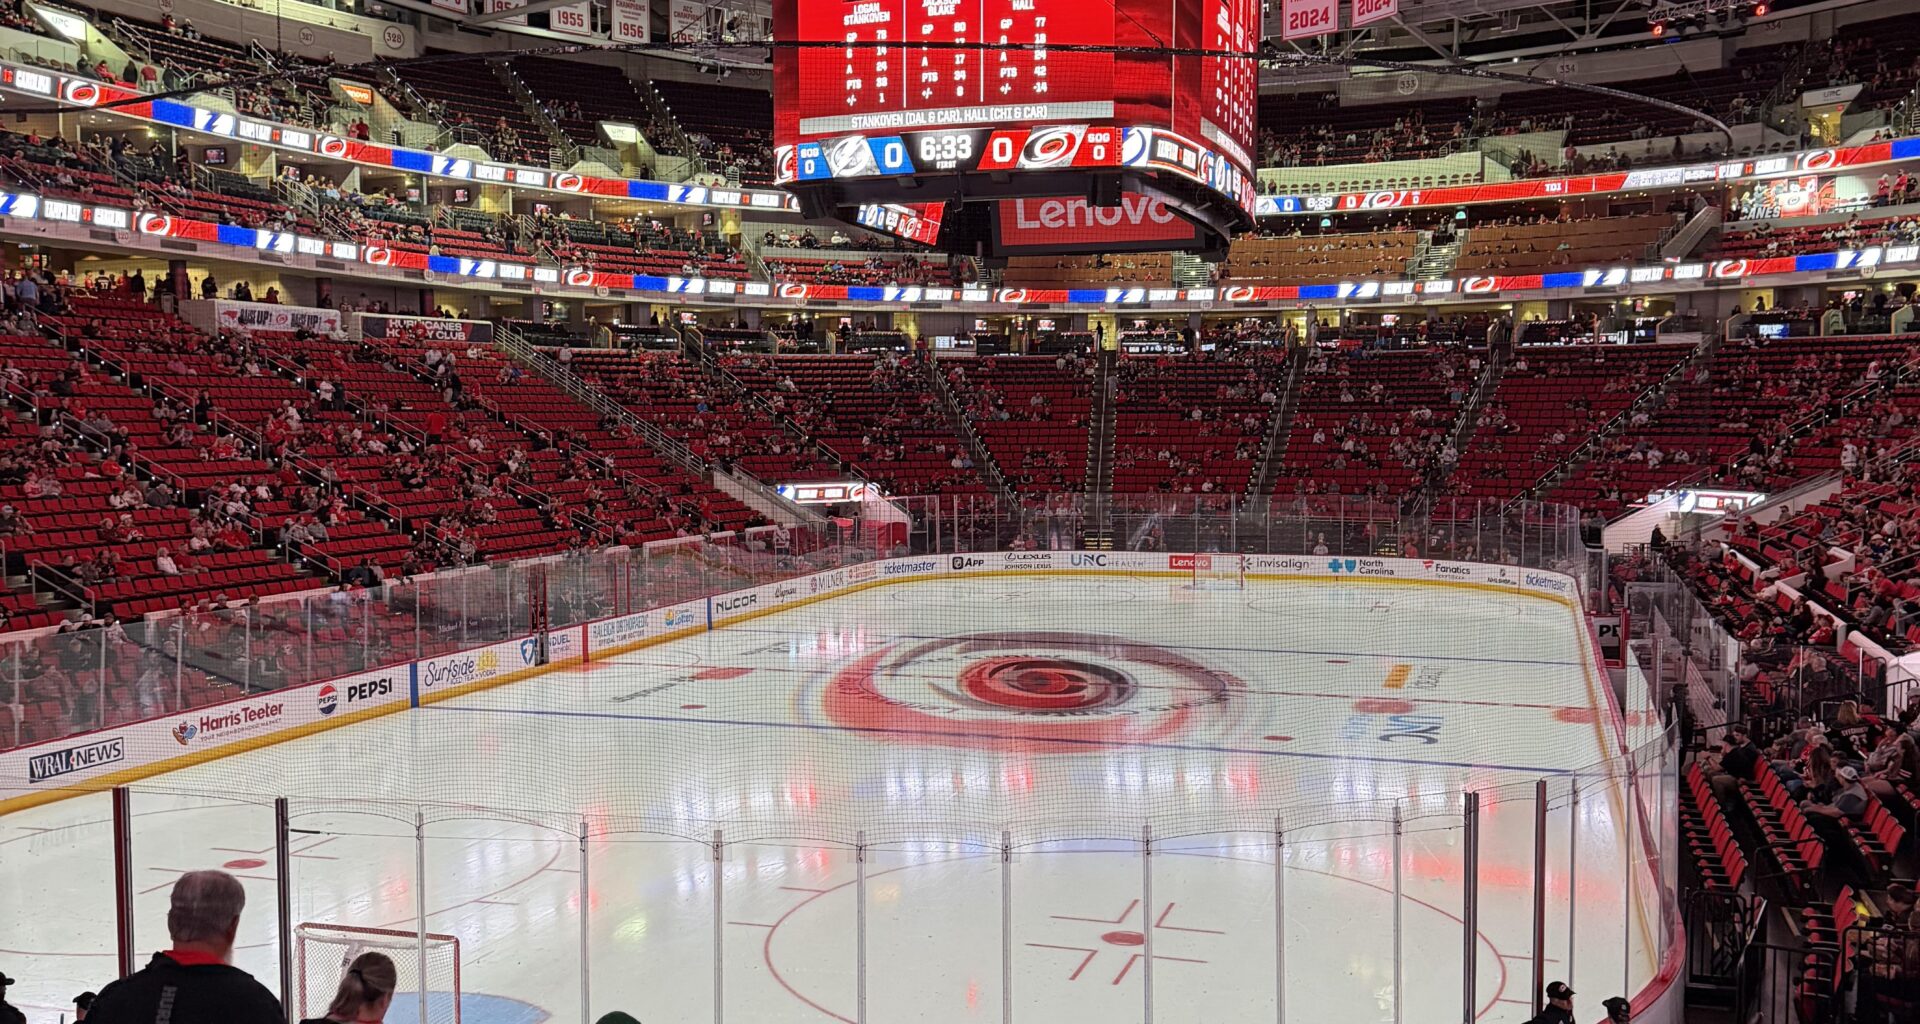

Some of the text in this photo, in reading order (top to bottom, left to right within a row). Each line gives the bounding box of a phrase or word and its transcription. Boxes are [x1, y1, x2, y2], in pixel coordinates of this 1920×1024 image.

[854, 3, 880, 14] LOGAN
[928, 5, 955, 16] BLAKE
[1012, 0, 1035, 10] HALL
[557, 10, 584, 27] 1955
[844, 11, 890, 25] STANKOVEN
[1000, 17, 1046, 29] GP 77
[1290, 6, 1330, 30] 2024
[618, 22, 644, 38] 1956
[922, 24, 934, 35] GP
[301, 32, 313, 40] 327
[386, 32, 402, 42] 328
[921, 54, 966, 67] A 17
[1000, 52, 1007, 62] A
[846, 64, 853, 74] A
[1000, 66, 1047, 78] PTS 42
[922, 72, 938, 83] PTS
[846, 79, 862, 90] PTS
[1033, 82, 1048, 93] -14
[879, 93, 885, 103] 1
[851, 104, 1048, 129] STANKOVEN (DAL & CAR), HALL (CHI & CAR)
[1087, 132, 1110, 143] SOG
[801, 147, 820, 158] SOG
[920, 134, 972, 161] 6:33
[992, 137, 1013, 163] 0
[1093, 145, 1106, 160] 0
[884, 142, 902, 169] 0
[804, 160, 815, 174] 0
[936, 160, 957, 169] FIRST
[1284, 199, 1294, 212] 0
[1346, 196, 1357, 208] 0
[1016, 195, 1177, 229] Lenovo
[1739, 206, 1781, 220] CANES
[389, 319, 462, 331] HURCANES
[386, 328, 466, 340] HOY CLUB
[1070, 554, 1144, 568] UNC HEALTH
[1172, 558, 1208, 567] Lenovo
[1256, 557, 1310, 571] invisalign
[1359, 559, 1384, 568] North
[884, 560, 937, 575] ticketmaster
[1359, 566, 1395, 576] Carolina
[1435, 563, 1471, 575] Fanatics
[818, 570, 844, 590] MILNER
[1525, 573, 1567, 592] ticketmaster
[716, 594, 758, 614] NUCOR
[675, 614, 694, 625] Lottery
[593, 621, 616, 639] RALEIGH
[424, 656, 475, 687] Surfside
[348, 677, 392, 703] PEPSI
[319, 695, 337, 705] PEPSI
[200, 703, 283, 733] Harris Teeter
[31, 742, 122, 781] WRAL NEWS
